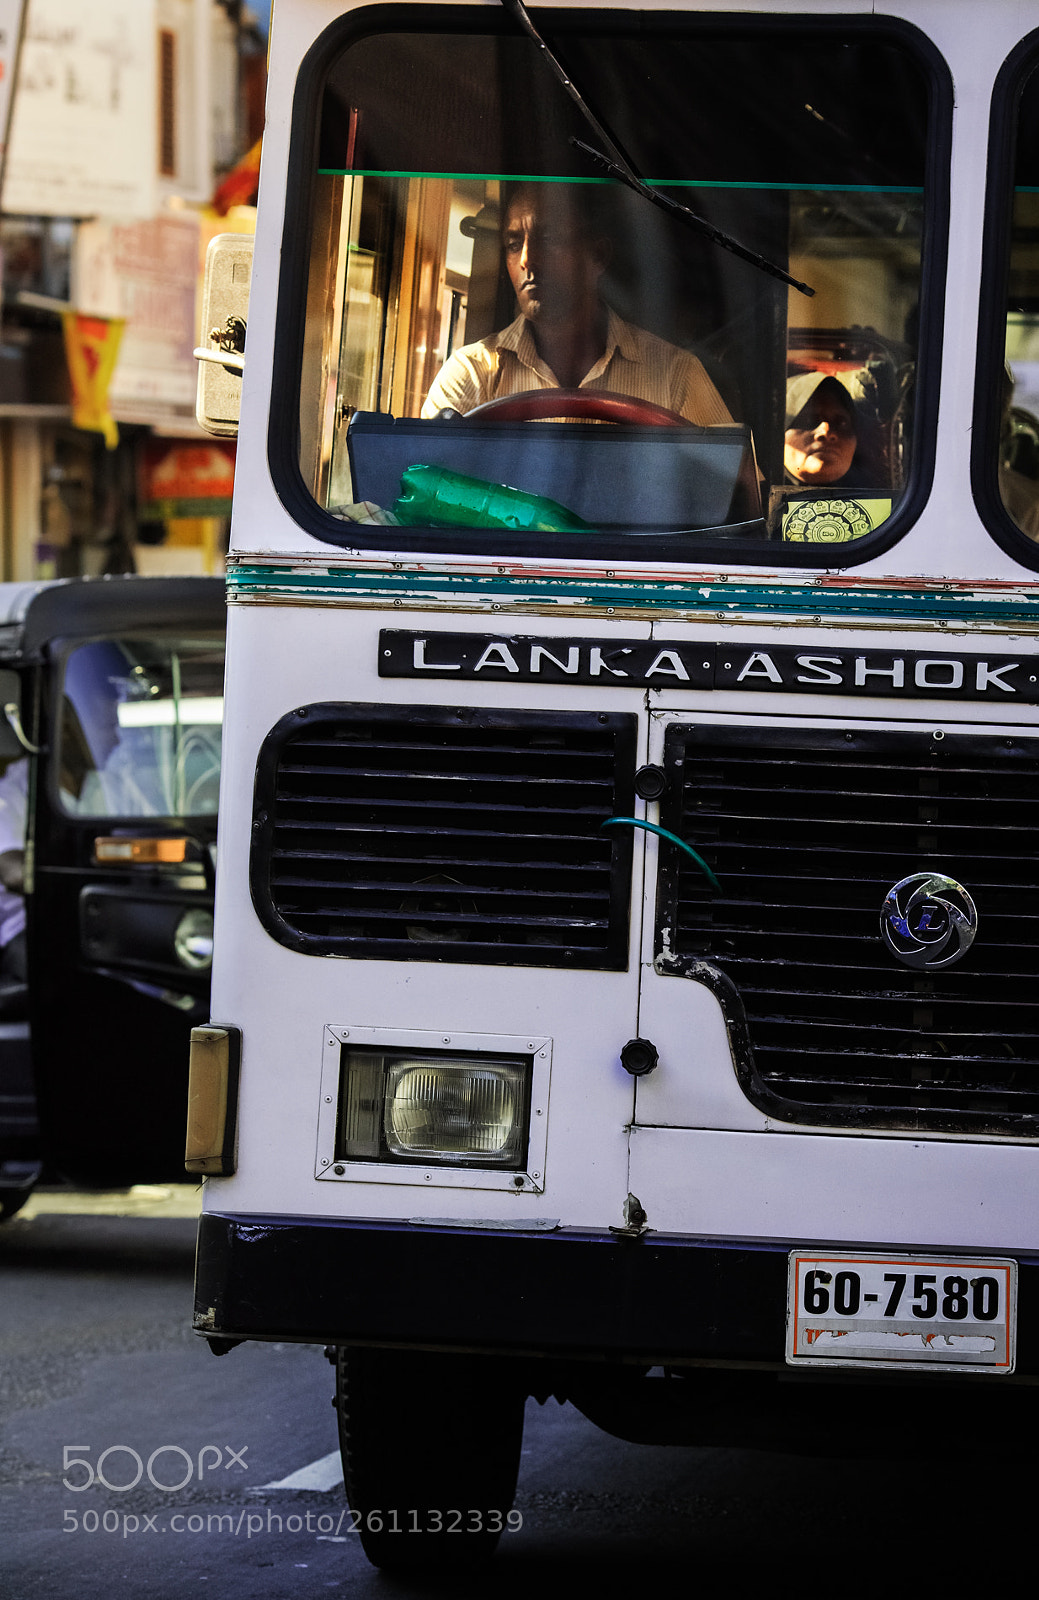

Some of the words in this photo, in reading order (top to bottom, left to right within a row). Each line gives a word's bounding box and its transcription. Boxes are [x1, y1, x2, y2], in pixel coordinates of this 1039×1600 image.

[413, 639, 690, 681] LANKA
[736, 651, 1020, 693] ASHOK
[803, 1269, 999, 1321] 60-7580
